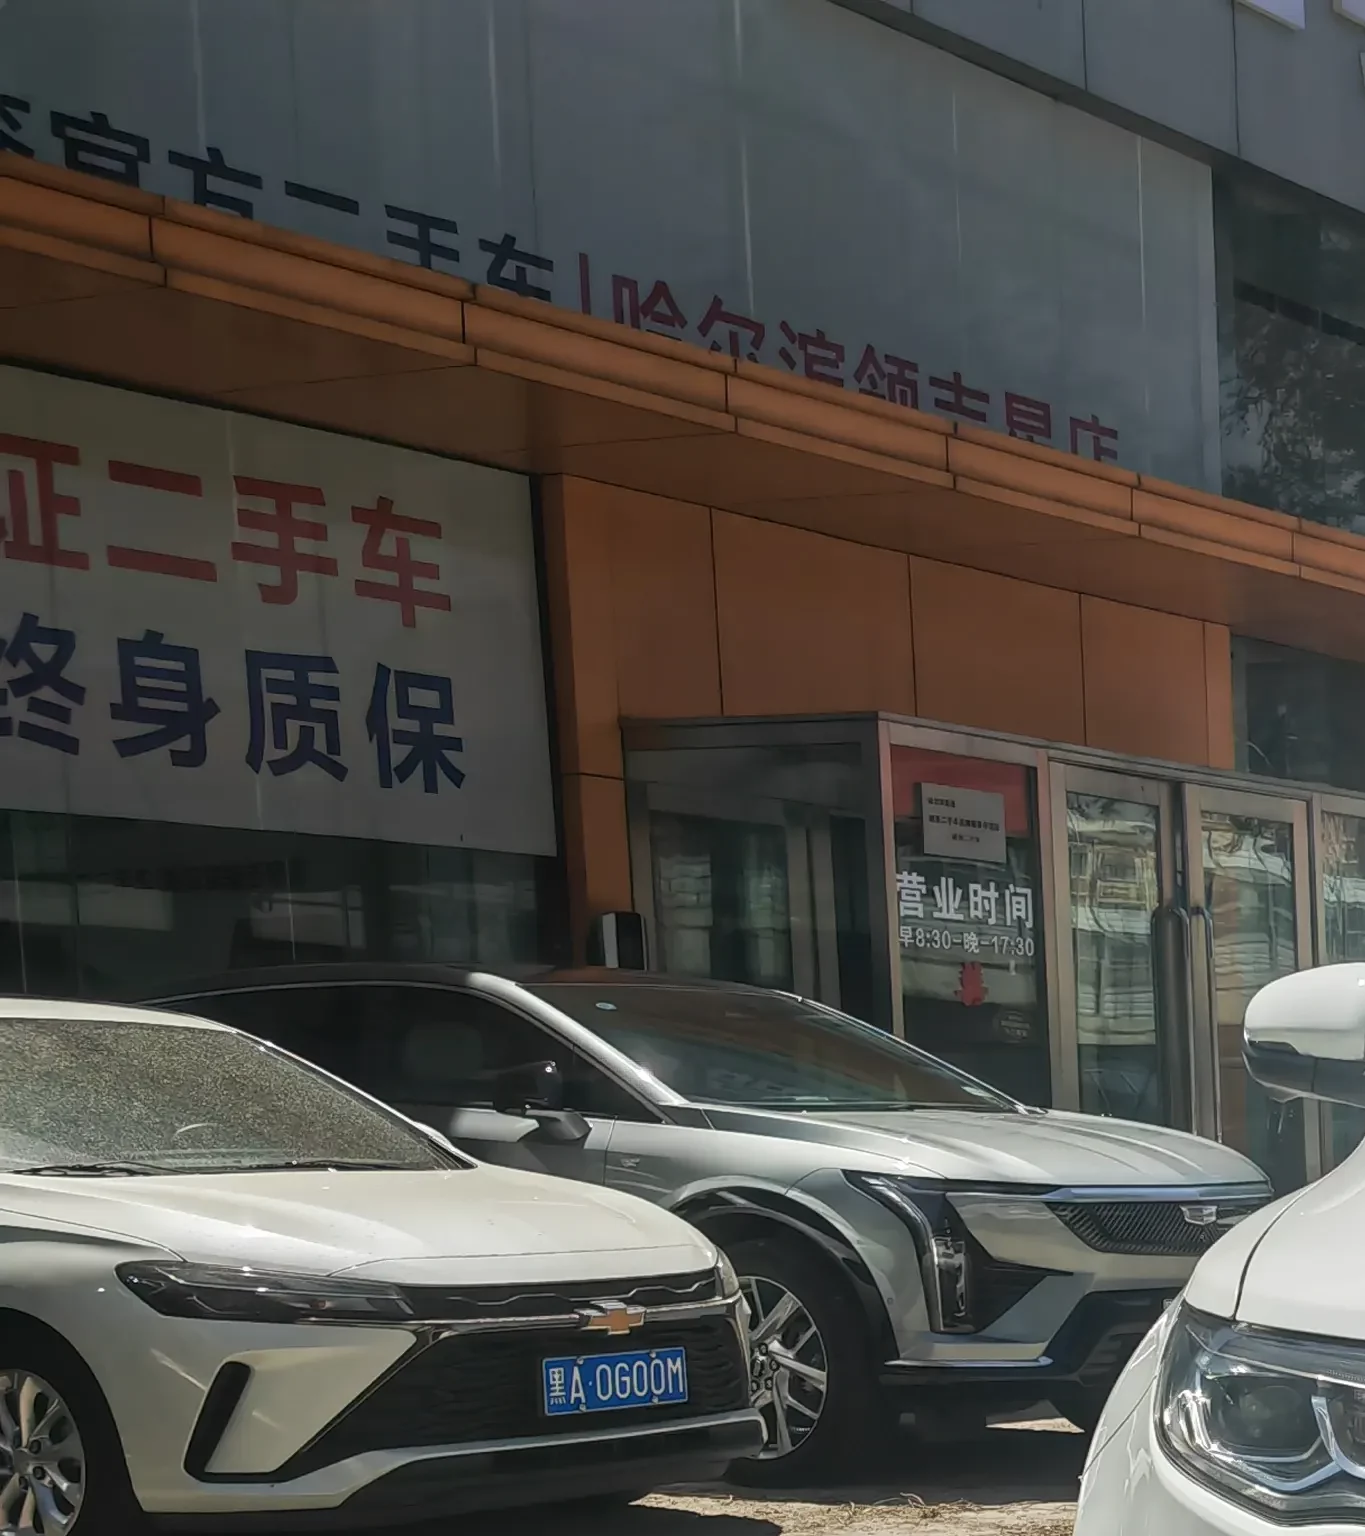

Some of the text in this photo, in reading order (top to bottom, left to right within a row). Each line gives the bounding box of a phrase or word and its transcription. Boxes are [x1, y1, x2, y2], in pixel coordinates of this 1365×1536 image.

[0, 612, 466, 794] 终身质保
[896, 871, 1033, 928] 营业时间
